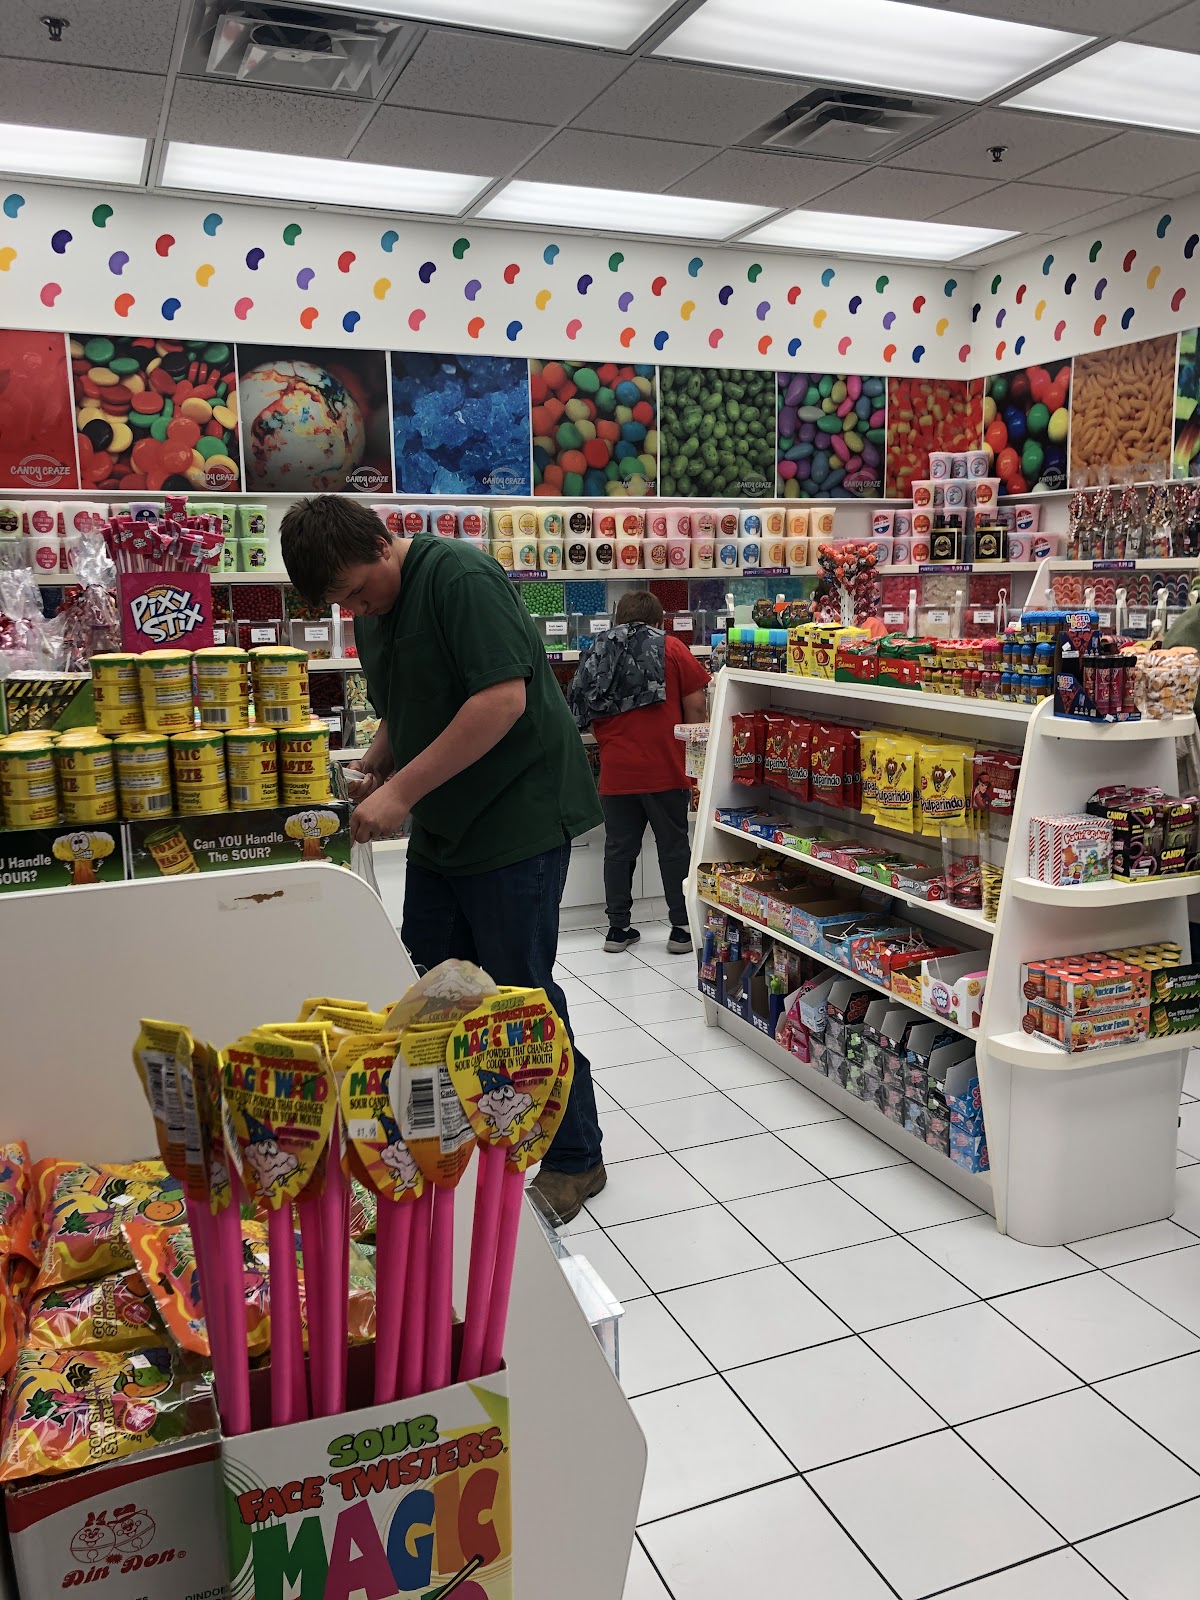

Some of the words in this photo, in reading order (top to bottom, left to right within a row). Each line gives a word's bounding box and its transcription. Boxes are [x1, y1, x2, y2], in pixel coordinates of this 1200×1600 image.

[10, 465, 42, 481] CANDY
[42, 466, 71, 475] CRAZE
[216, 473, 238, 481] CRAZE
[346, 475, 369, 488] CANDY
[369, 475, 389, 483] CRAZE
[482, 476, 505, 488] CANDY
[505, 477, 526, 485] CRAZE
[737, 481, 755, 492] CANDY
[843, 480, 864, 492] CANDY
[863, 480, 882, 488] CRAZE
[1066, 614, 1090, 624] LASER
[1071, 621, 1086, 629] POP
[1106, 811, 1128, 820] CANDY
[193, 838, 216, 850] Can
[218, 835, 242, 848] YOU
[246, 832, 284, 846] Handle
[8, 854, 52, 870] Handle
[208, 852, 228, 863] The
[232, 846, 272, 861] SOUR?
[1161, 848, 1186, 860] CANDY
[702, 982, 716, 999] PEZ
[727, 998, 742, 1016] PEZ
[752, 1015, 768, 1034] PEZ
[453, 1024, 502, 1061] MAGIC
[506, 1016, 556, 1047] WAND
[454, 1060, 470, 1072] SOUR
[470, 1052, 485, 1068] CANDY
[486, 1047, 511, 1060] POWDER
[512, 1044, 526, 1056] THAT
[527, 1042, 553, 1054] CHANGES
[486, 1057, 506, 1070] COLOR
[508, 1058, 514, 1068] IN
[516, 1056, 530, 1066] YOUR
[532, 1053, 553, 1065] MOUTH
[274, 1069, 328, 1103] WAND
[350, 1070, 392, 1098] MAG
[350, 1098, 368, 1110] SOUR
[98, 1392, 119, 1455] SABORES
[327, 1415, 440, 1468] SOUR
[237, 1476, 324, 1524] FACE
[329, 1426, 504, 1501] TWISTERS
[252, 1467, 502, 1600] MAGIC
[62, 1565, 110, 1589] Din
[120, 1548, 176, 1574] Don
